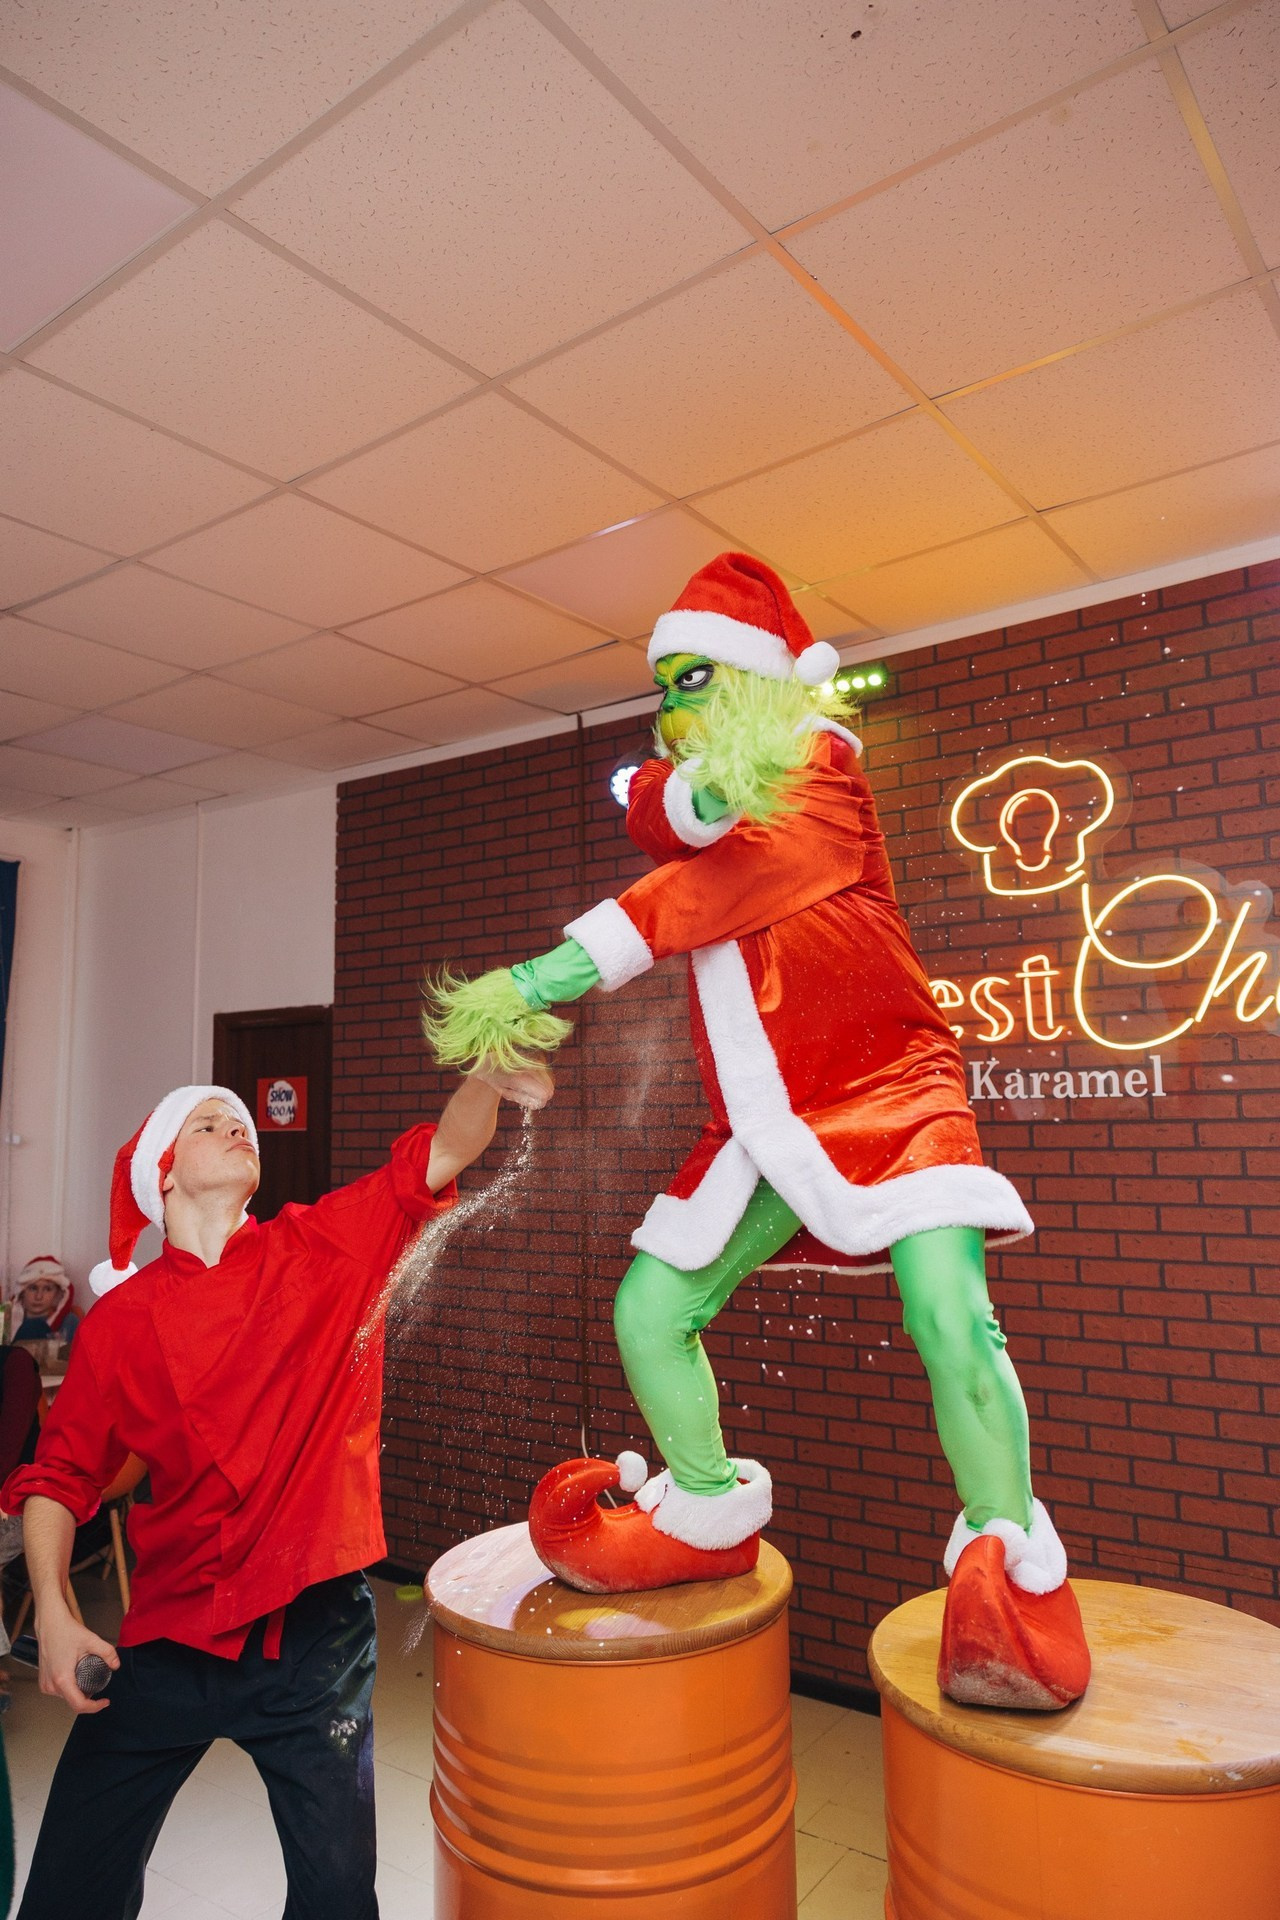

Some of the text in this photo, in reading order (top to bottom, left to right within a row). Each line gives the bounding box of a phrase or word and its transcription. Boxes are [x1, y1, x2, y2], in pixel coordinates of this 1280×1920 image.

[928, 874, 1280, 1050] est Ch
[968, 1055, 1167, 1100] Karamel
